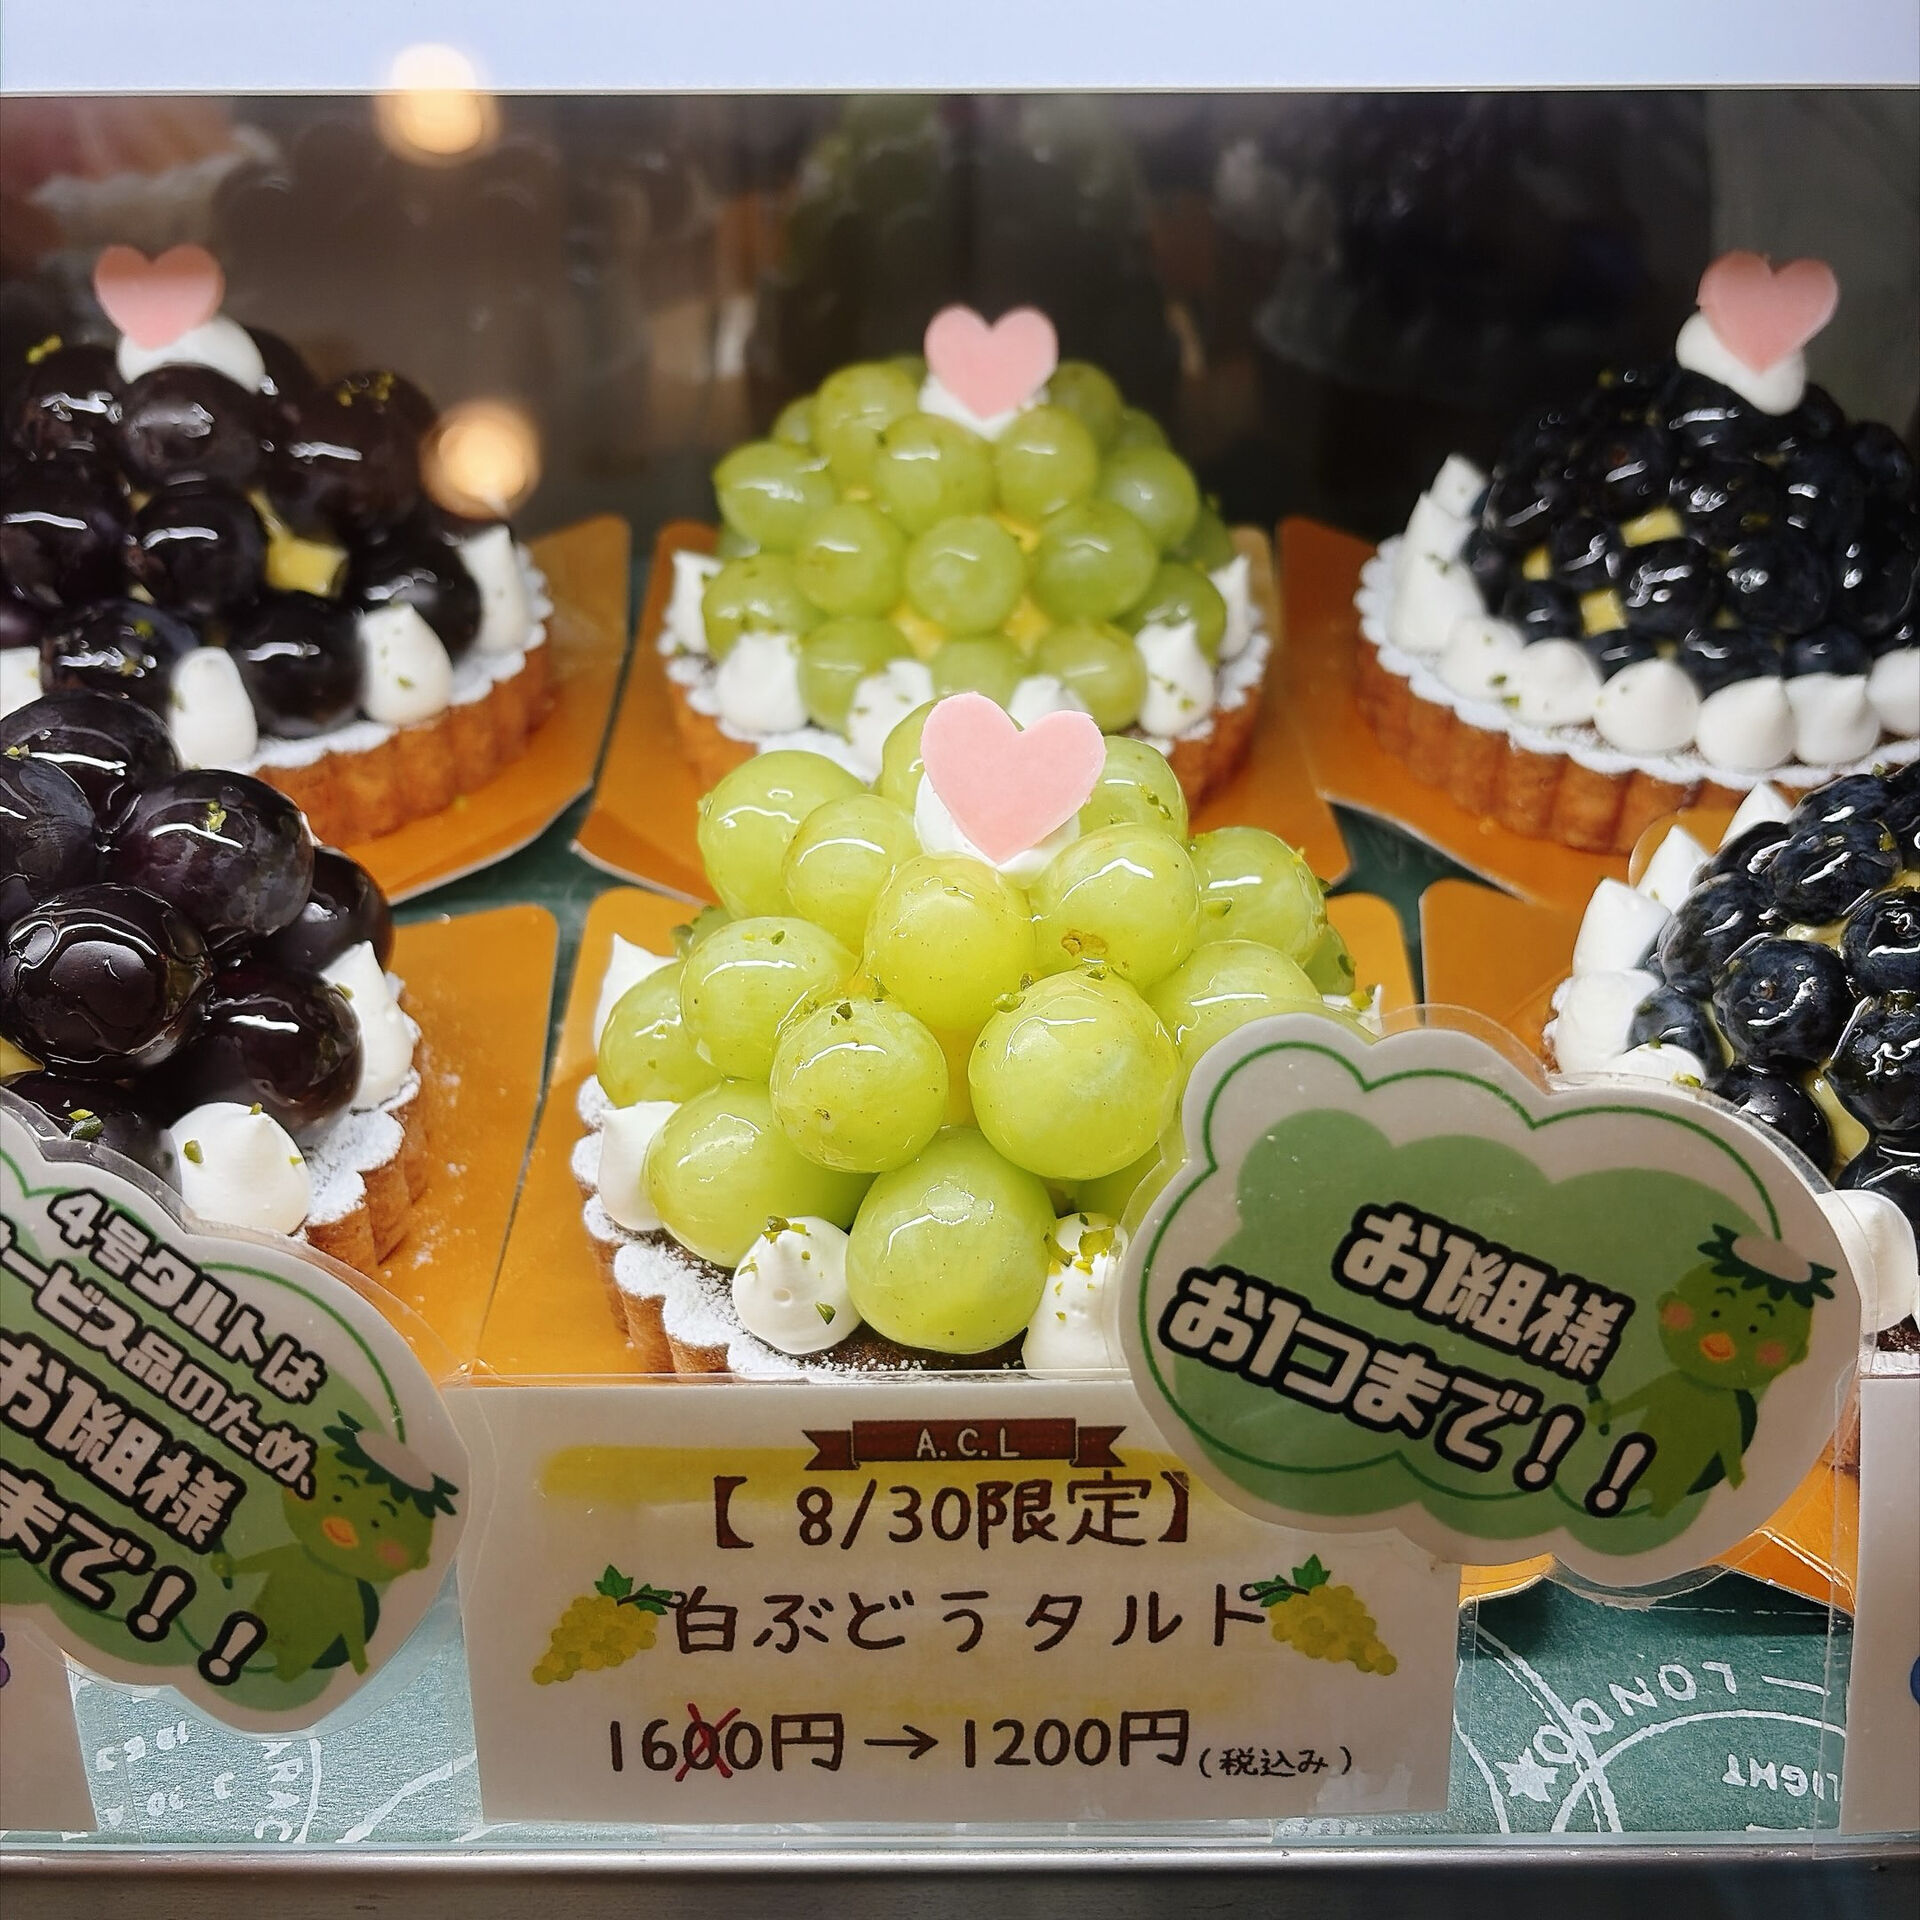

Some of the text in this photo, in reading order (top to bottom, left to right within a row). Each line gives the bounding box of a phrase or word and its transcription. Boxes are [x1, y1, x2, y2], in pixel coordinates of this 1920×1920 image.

[48, 1188, 327, 1405] 4号タルトは
[1332, 1203, 1636, 1383] お1組様
[915, 1427, 1021, 1460] A.C.L
[676, 1583, 1265, 1654] 白ぶどうタルト
[964, 1709, 1190, 1768] 1200円
